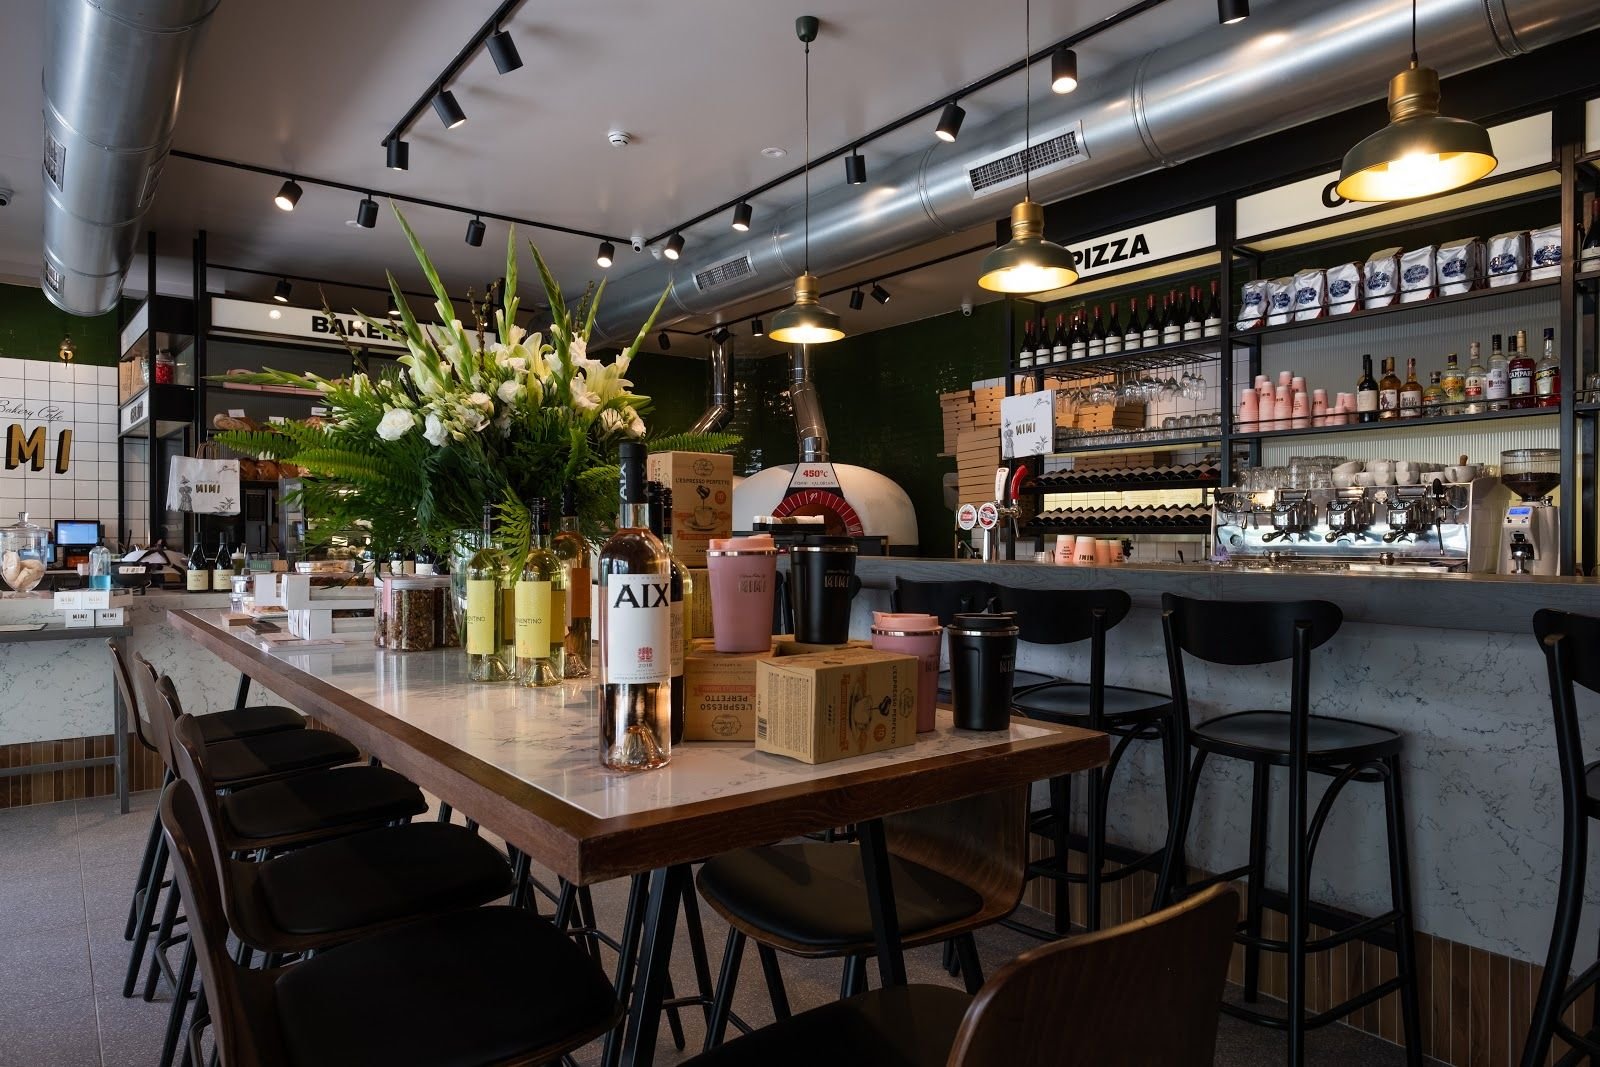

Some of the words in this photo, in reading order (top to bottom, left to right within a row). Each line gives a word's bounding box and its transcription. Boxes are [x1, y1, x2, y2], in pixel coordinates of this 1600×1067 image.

[1071, 234, 1150, 270] PIZZA
[311, 315, 409, 341] BAKER
[1509, 371, 1533, 379] CAMPARI
[1016, 422, 1036, 436] MIMI
[620, 462, 628, 501] AIX
[195, 484, 220, 494] MIMI
[613, 583, 669, 609] AIX
[705, 694, 748, 702] PERFETTO
[700, 703, 753, 711] L'ESPRESSO
